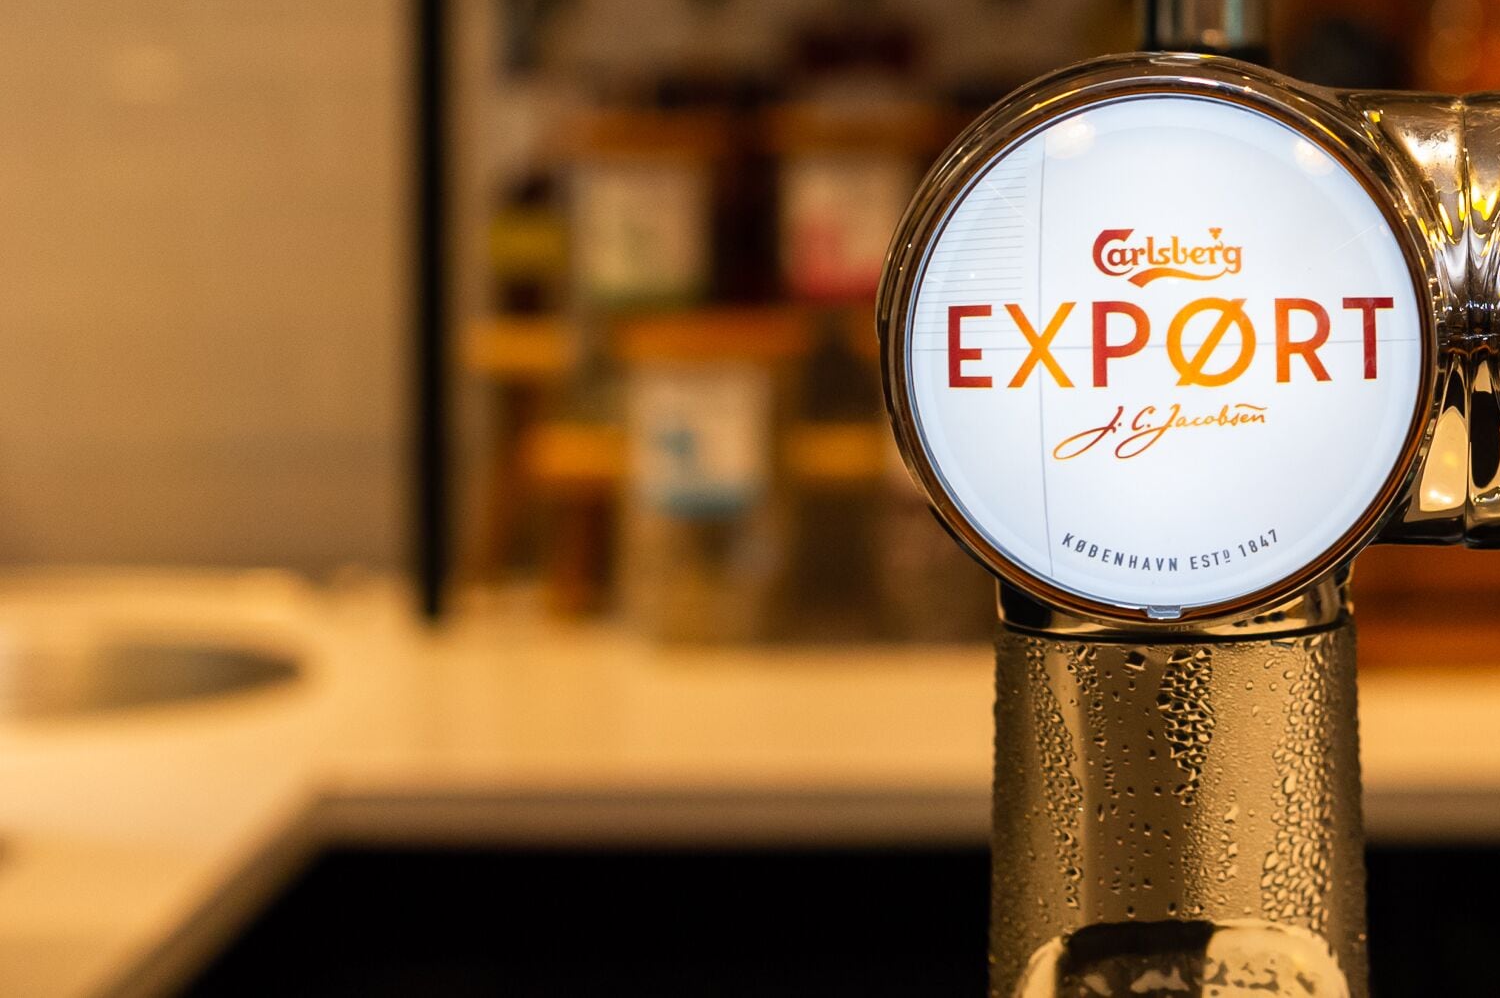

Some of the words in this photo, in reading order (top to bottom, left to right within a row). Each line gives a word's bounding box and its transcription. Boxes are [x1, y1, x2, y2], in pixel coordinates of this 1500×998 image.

[1092, 227, 1242, 288] Carlsberg
[948, 297, 1394, 388] EXPØRT
[1061, 532, 1178, 572] KØBENHAVN
[1237, 528, 1278, 558] 1847
